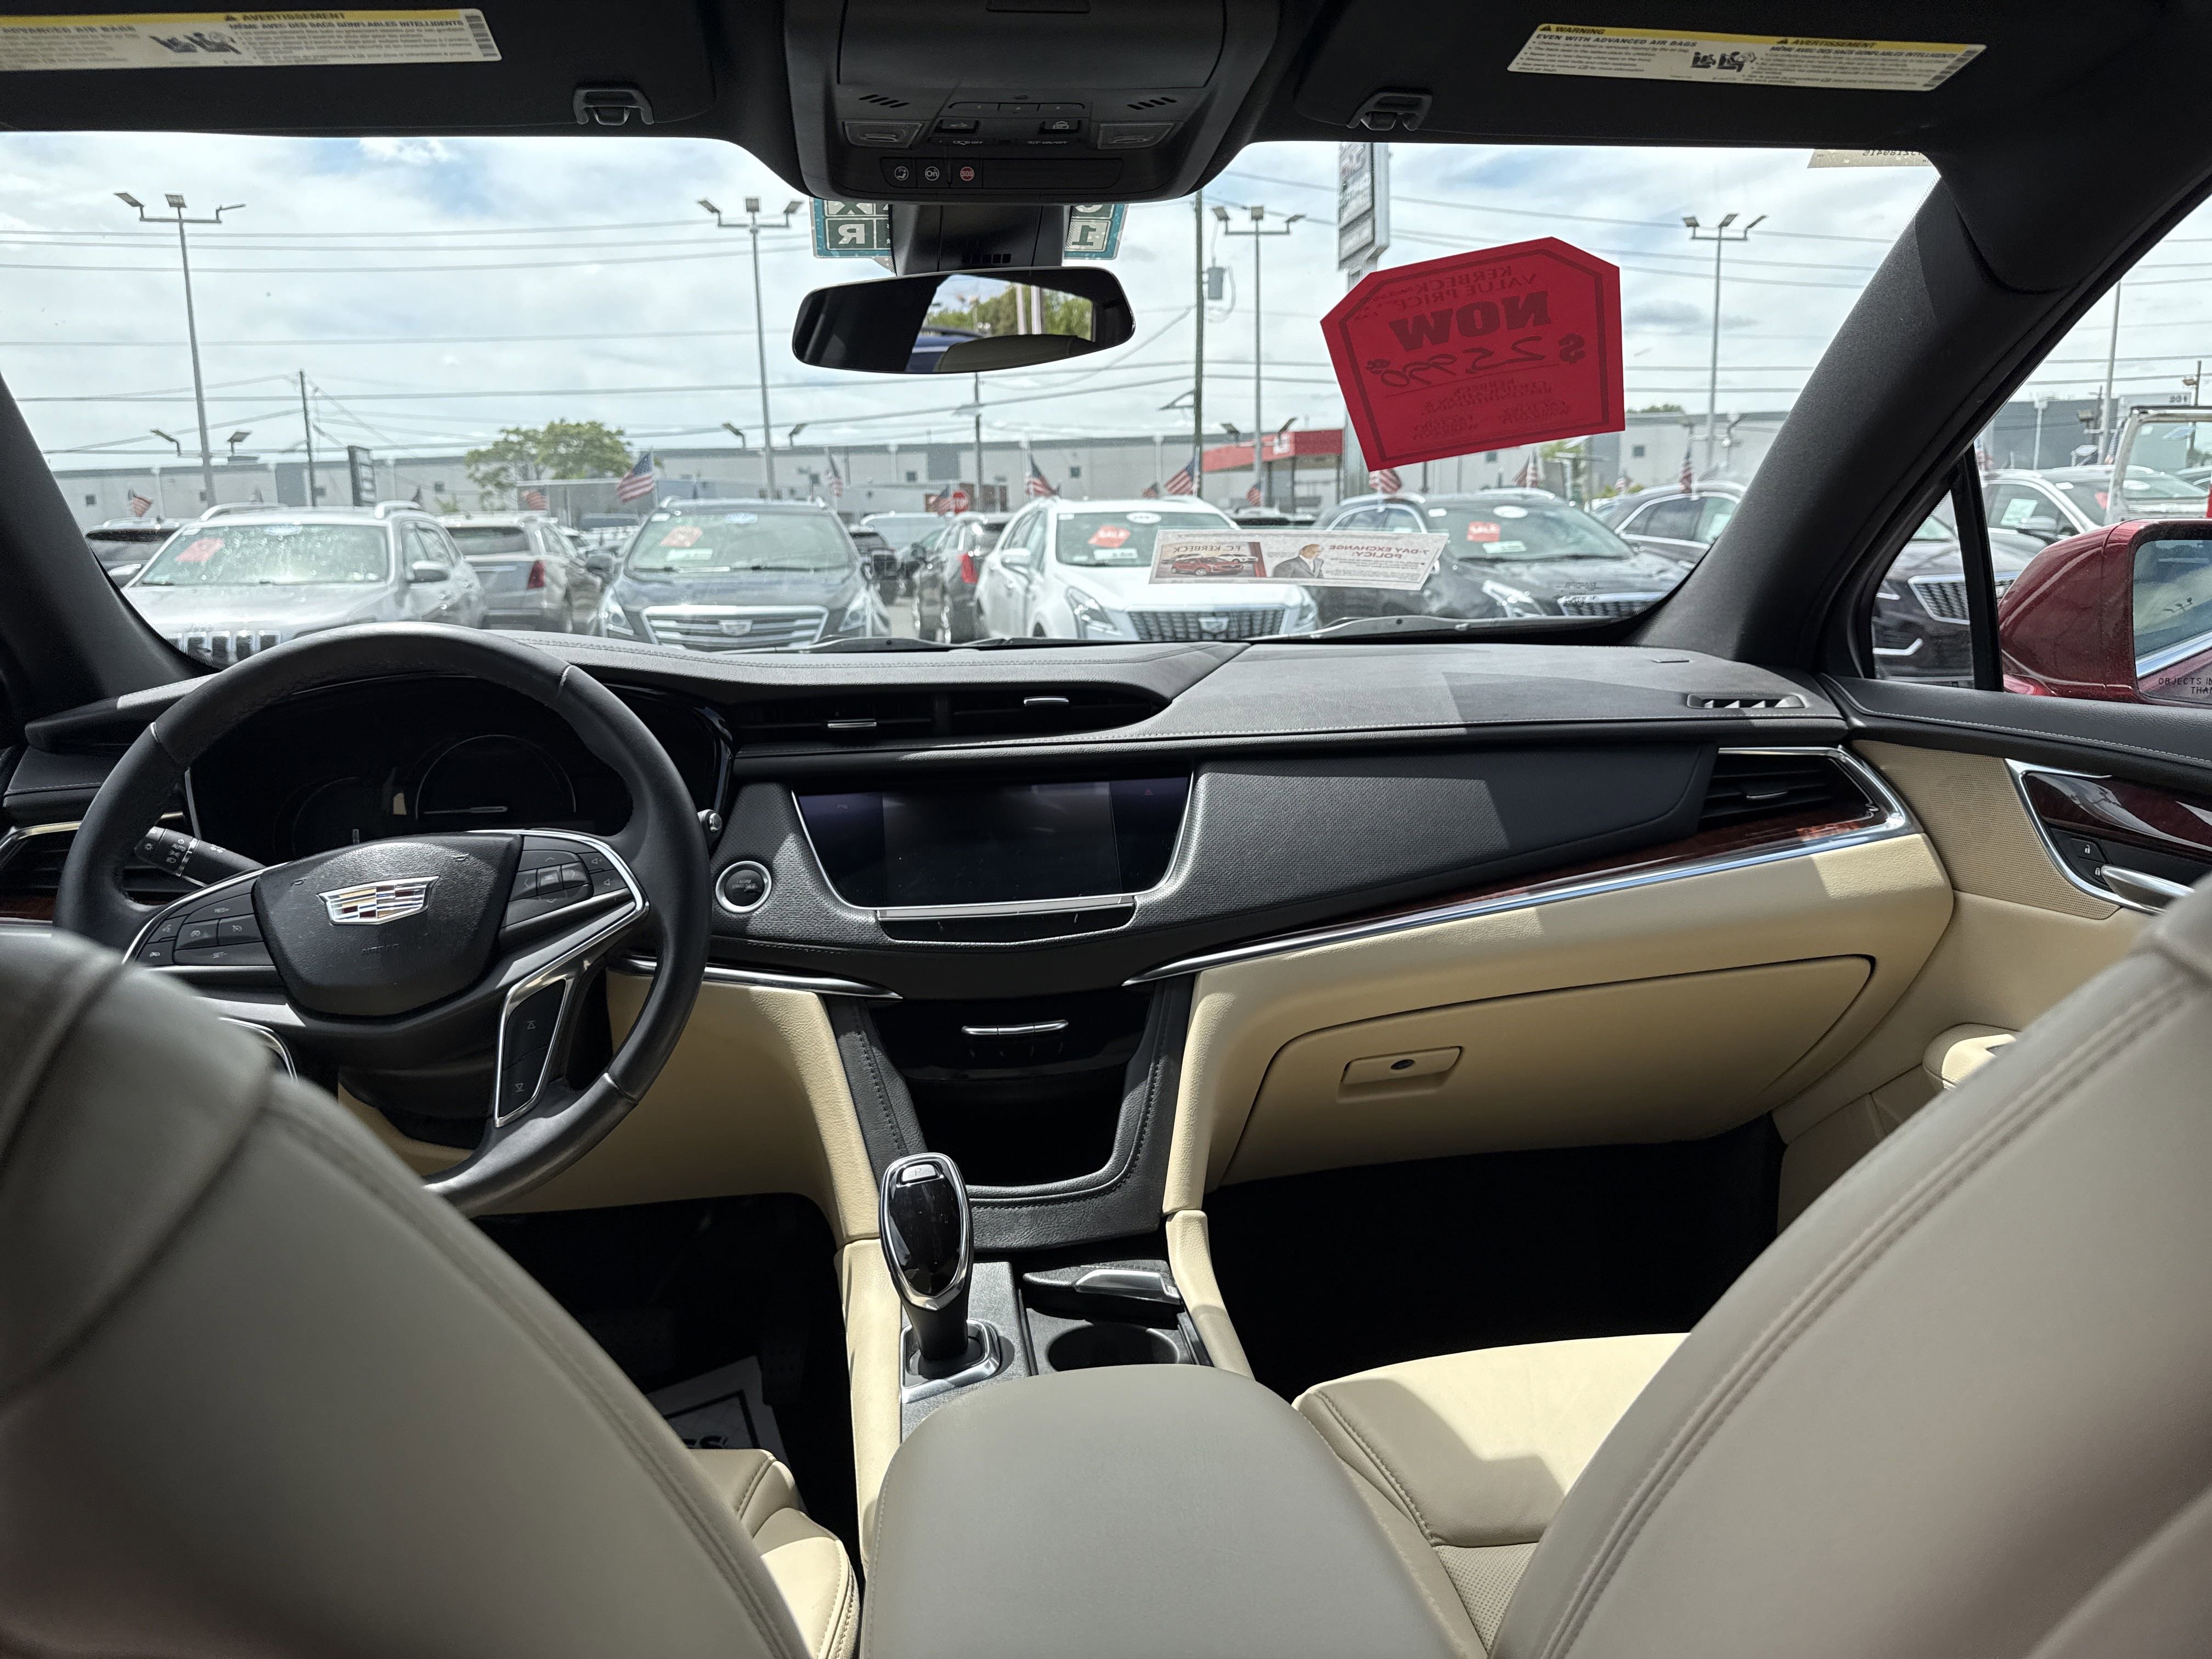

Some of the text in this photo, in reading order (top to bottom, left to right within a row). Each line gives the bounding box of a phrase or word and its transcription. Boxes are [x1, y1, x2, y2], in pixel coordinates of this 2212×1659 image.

[1555, 26, 1606, 35] WARNING
[1792, 39, 1877, 48] AVERTISSEMENT
[172, 843, 187, 852] AUTO
[915, 1167, 922, 1177] P
